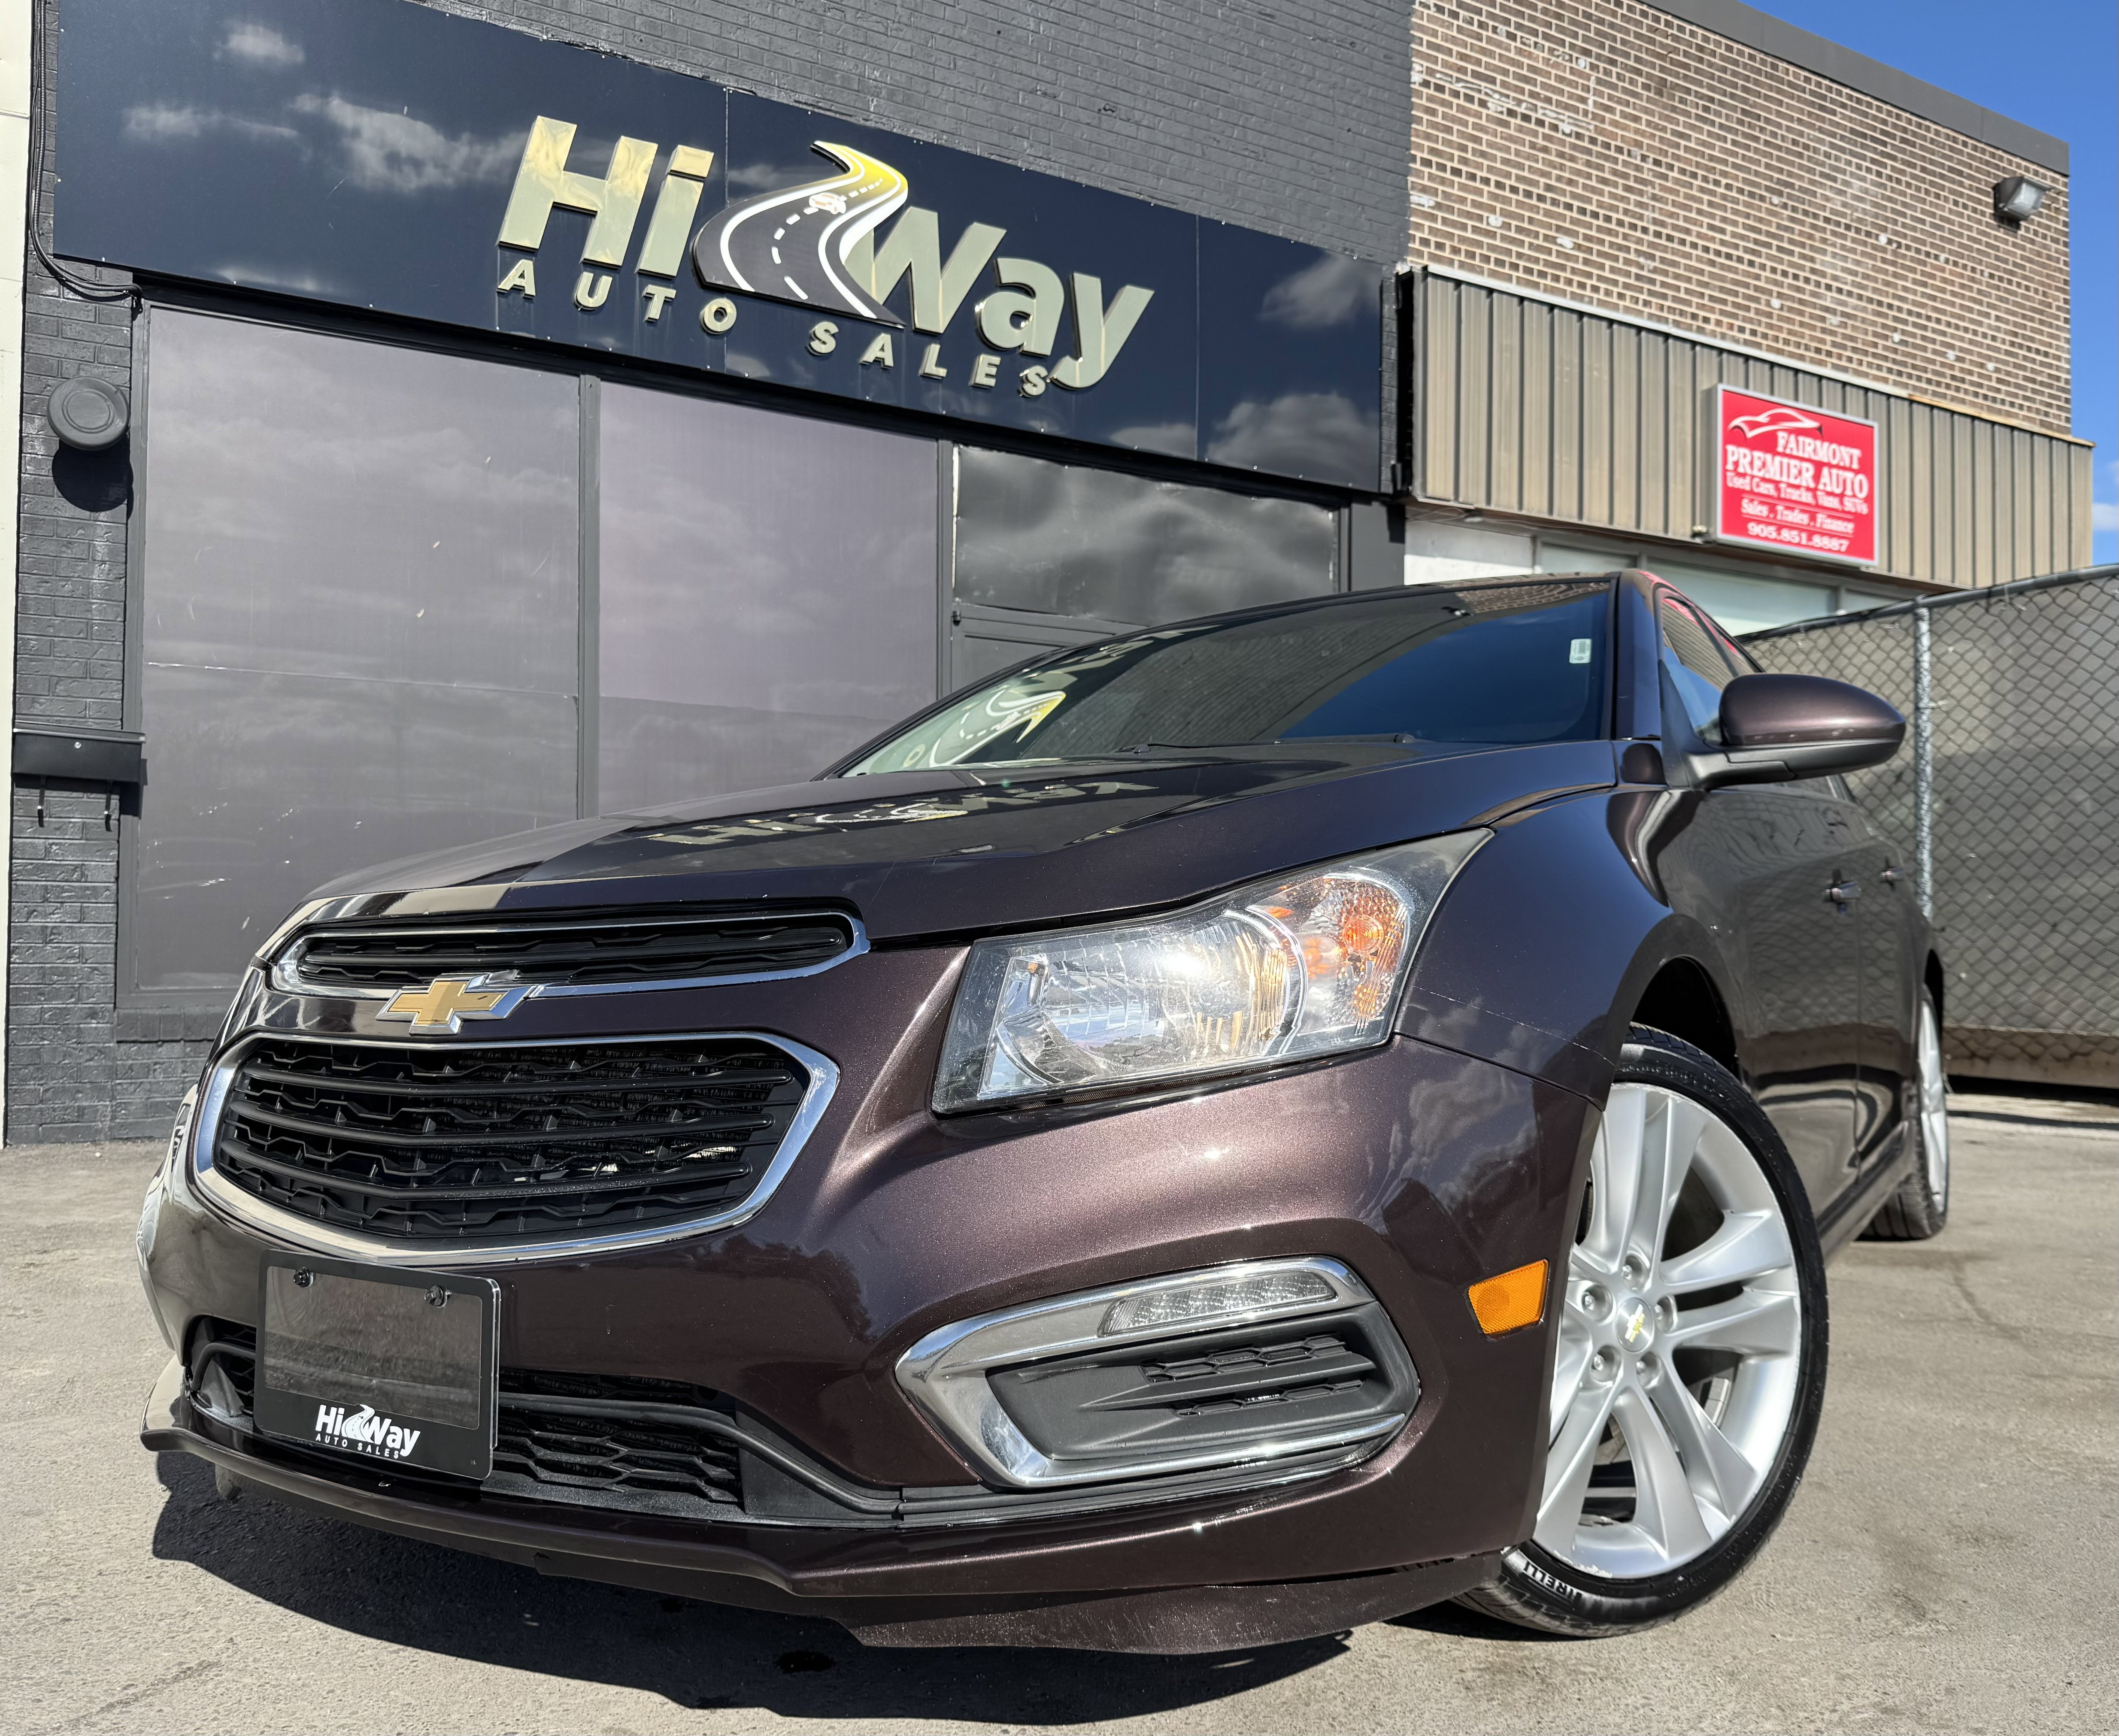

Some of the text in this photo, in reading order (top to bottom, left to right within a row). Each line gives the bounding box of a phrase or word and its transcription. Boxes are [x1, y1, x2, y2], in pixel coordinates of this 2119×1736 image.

[497, 258, 1048, 398] AUTO SALES
[1776, 431, 1862, 469] FAIRMONT
[1725, 445, 1868, 499] PREMIER AUTO
[1726, 472, 1751, 491] Used
[1752, 476, 1778, 498] Cars,
[1779, 483, 1816, 506] Trucks,
[1816, 491, 1843, 511] Vans,
[1741, 498, 1769, 518] Sales
[1816, 513, 1855, 534] Finance
[315, 1433, 399, 1459] AUTO SALES
